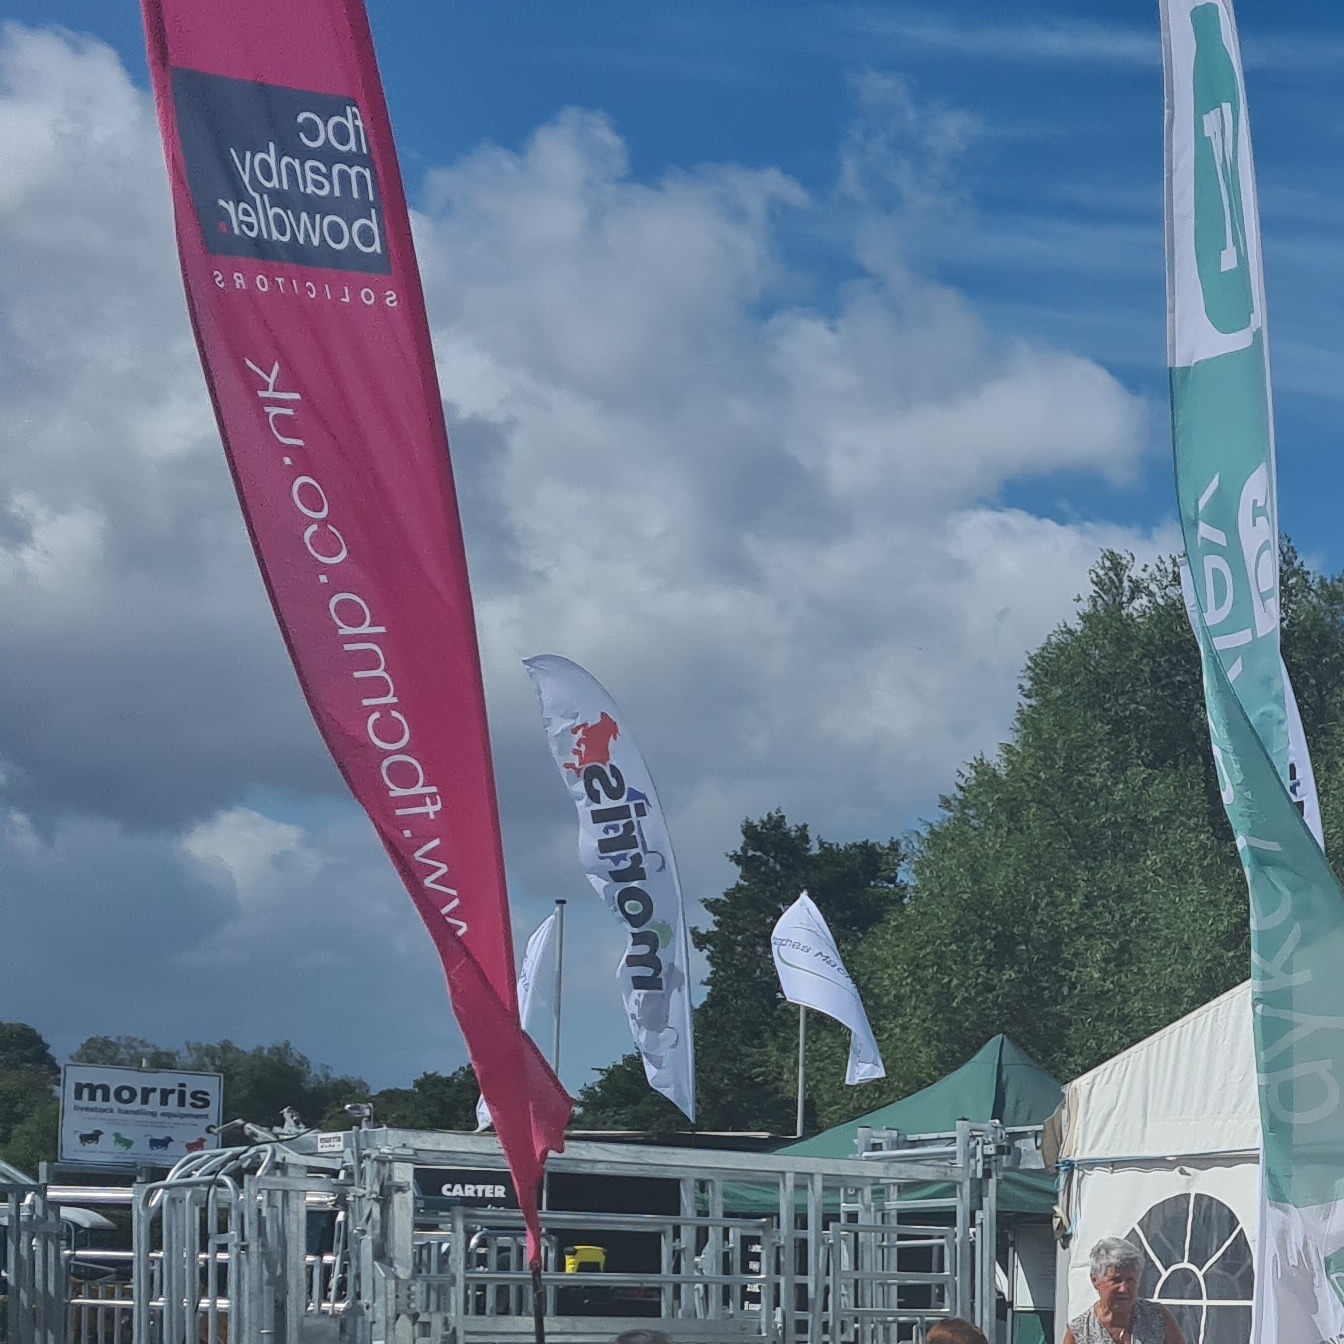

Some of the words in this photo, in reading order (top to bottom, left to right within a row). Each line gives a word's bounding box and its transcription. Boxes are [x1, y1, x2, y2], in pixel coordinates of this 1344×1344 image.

[74, 1082, 211, 1109] morris
[73, 1105, 114, 1114] livestock
[117, 1107, 158, 1117] handling
[160, 1111, 209, 1120] equipment
[441, 1184, 506, 1198] CARTER
